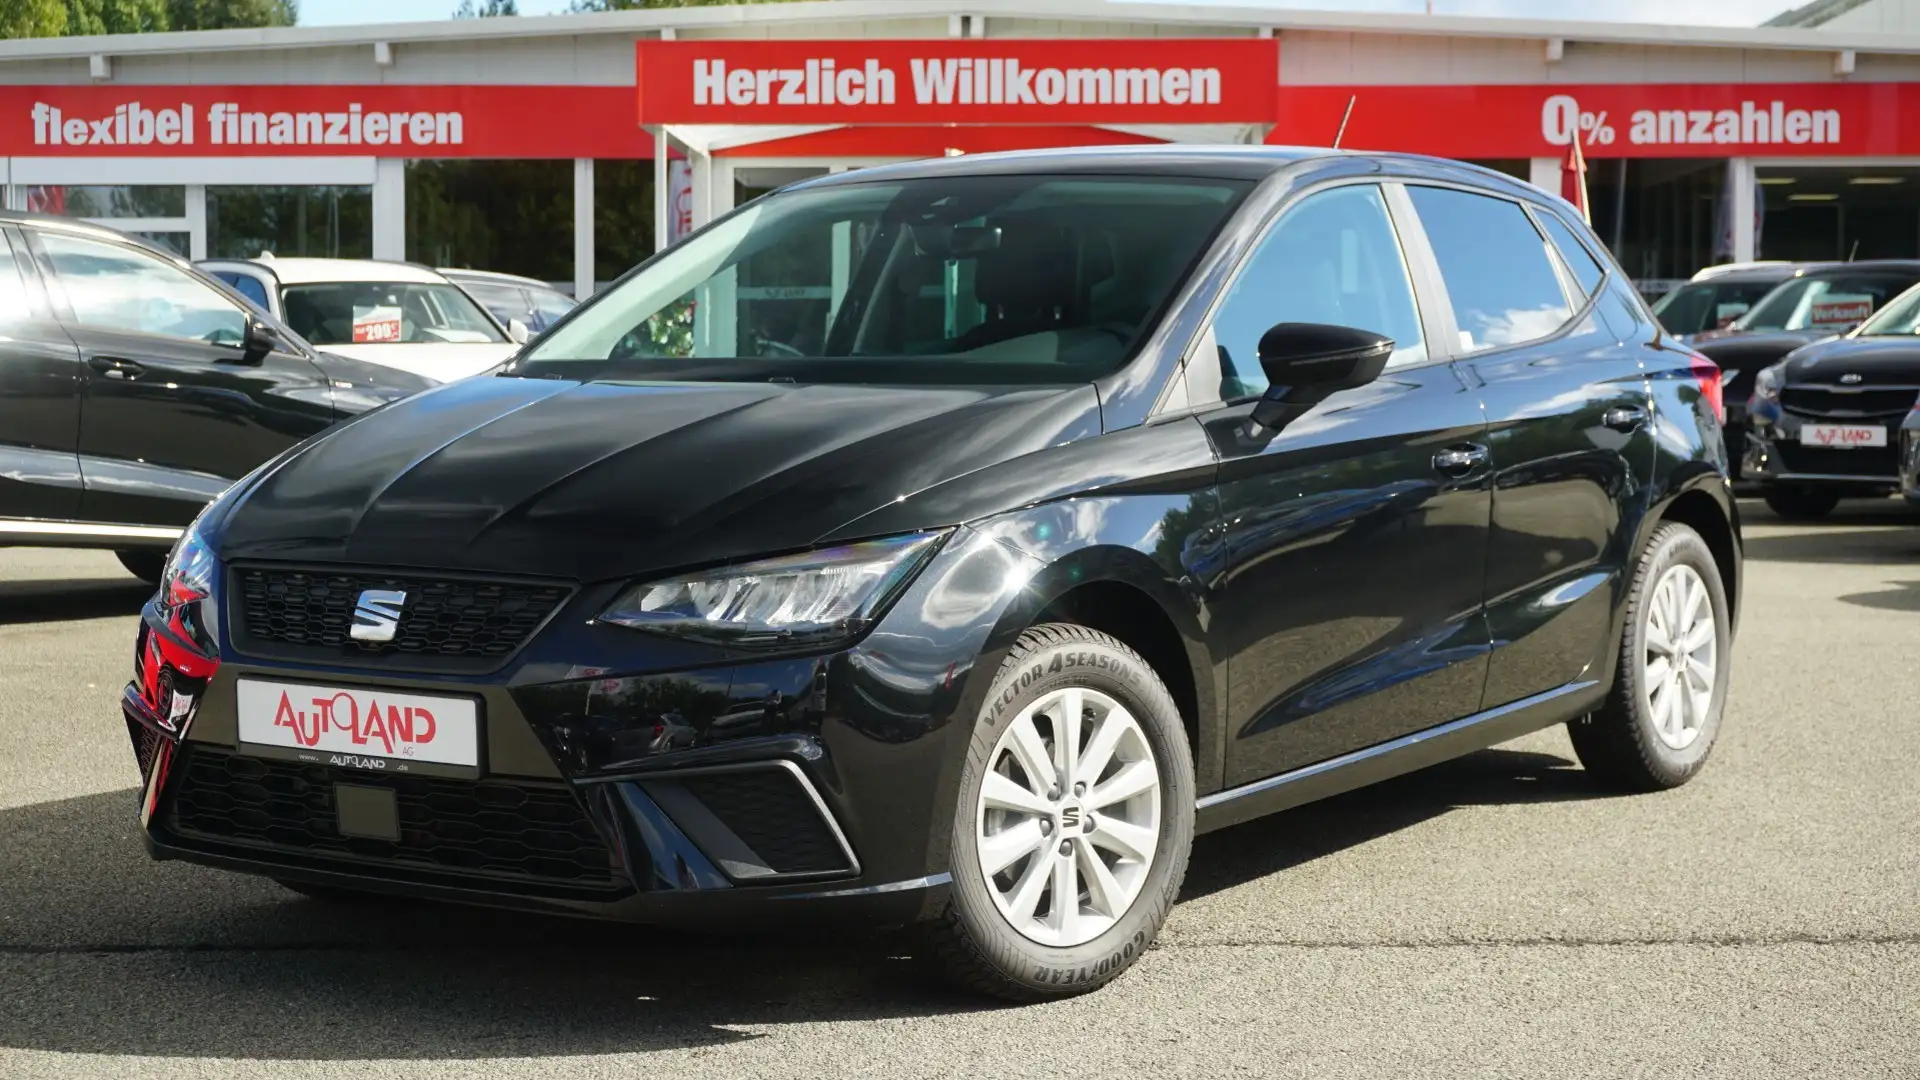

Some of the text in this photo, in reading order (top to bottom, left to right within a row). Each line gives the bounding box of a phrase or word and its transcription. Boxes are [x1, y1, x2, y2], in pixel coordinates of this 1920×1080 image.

[693, 57, 1221, 106] Herzlich Willkommen
[31, 101, 463, 146] flexibel finanzieren
[1542, 94, 1840, 146] 0% anzahlen
[983, 664, 1043, 727] VECTOR
[273, 689, 437, 754] AUTOLAND
[329, 755, 386, 770] AUTOLAND
[402, 747, 414, 757] AG
